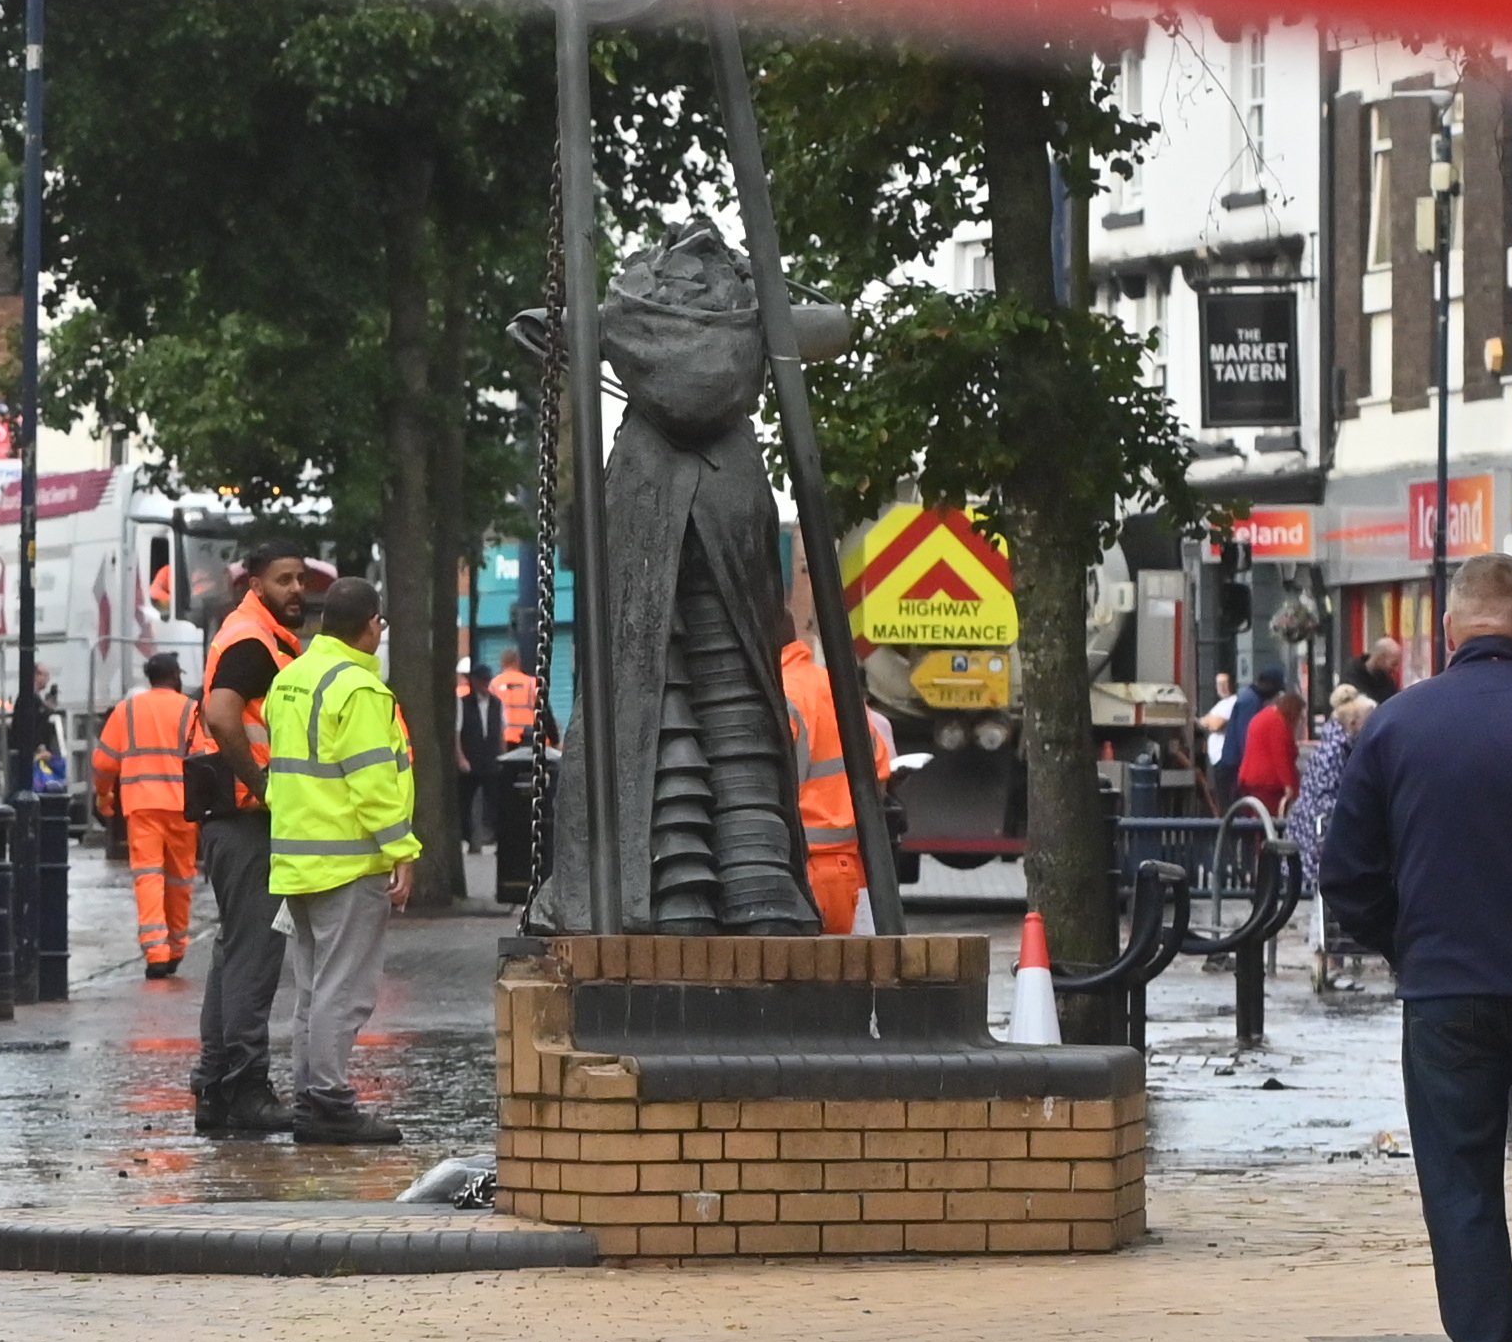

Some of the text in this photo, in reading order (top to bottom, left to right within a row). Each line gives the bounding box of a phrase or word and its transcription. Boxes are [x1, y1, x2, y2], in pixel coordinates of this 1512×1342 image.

[1237, 328, 1261, 342] THE
[1209, 341, 1289, 362] MARKET
[1212, 362, 1287, 383] TAVERN
[898, 601, 982, 617] HIGHWAY
[872, 624, 1008, 641] MAINTENANCE
